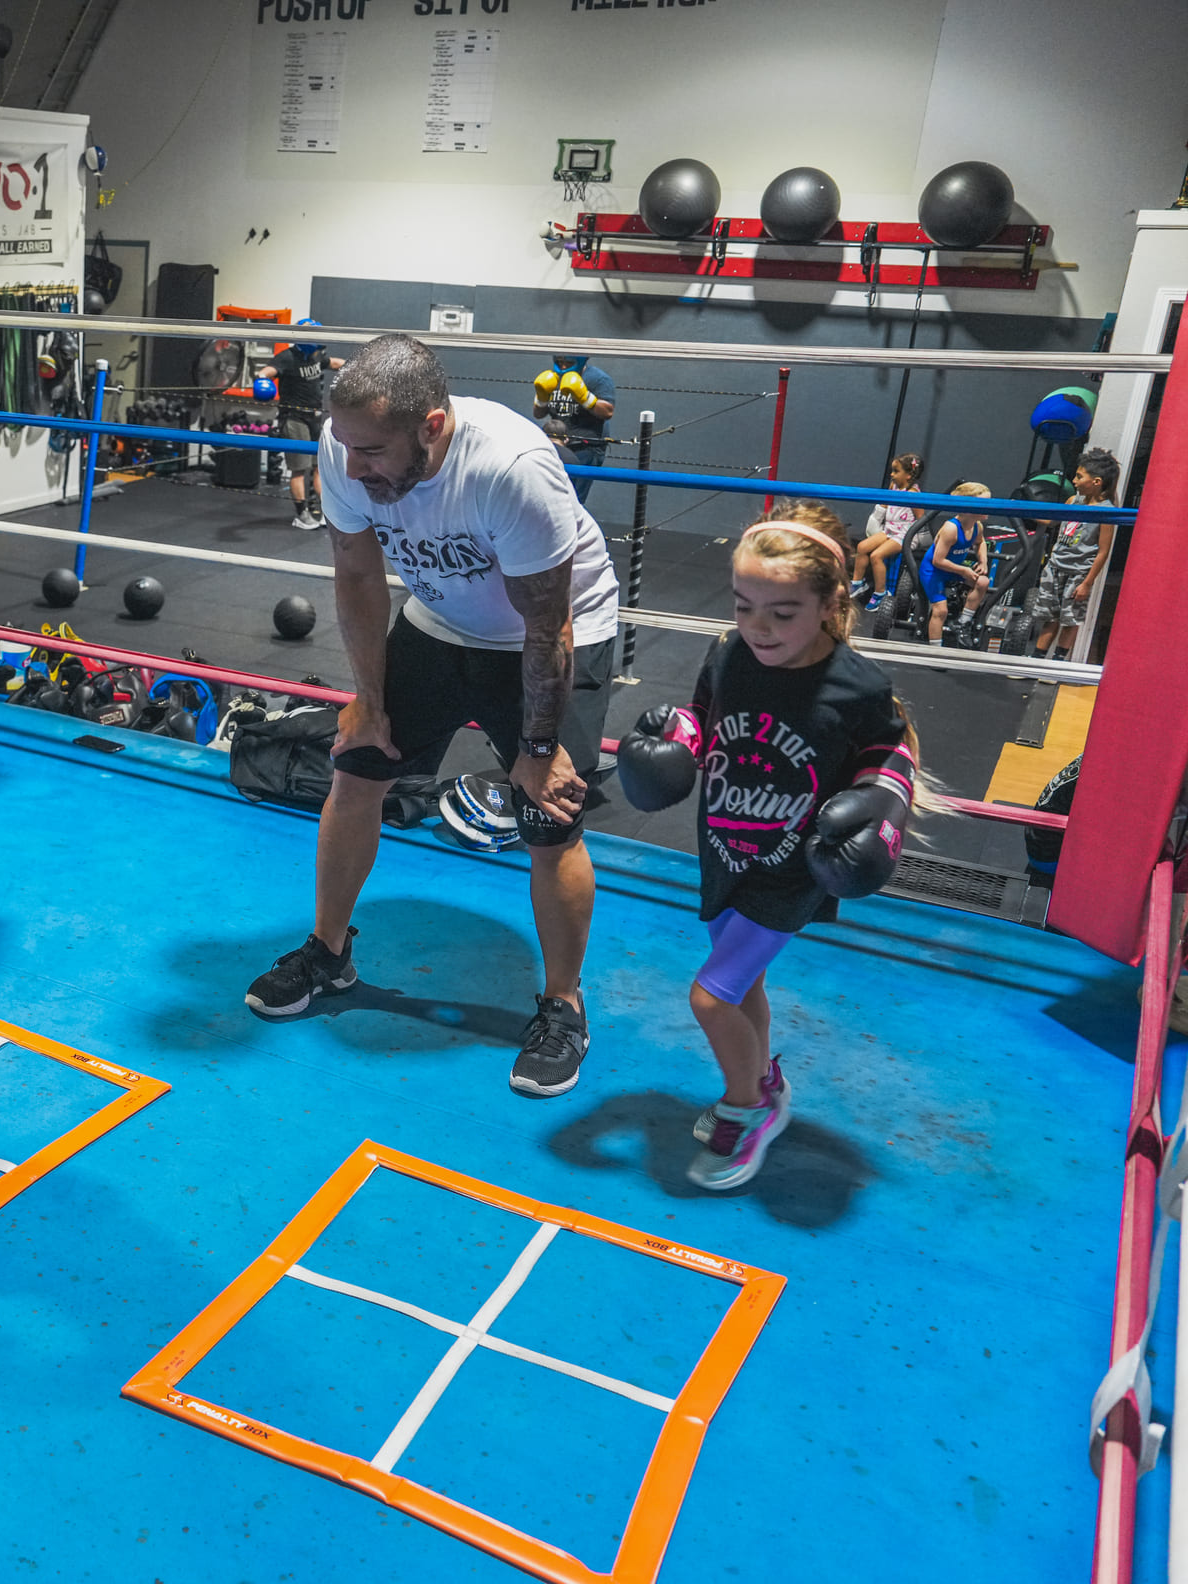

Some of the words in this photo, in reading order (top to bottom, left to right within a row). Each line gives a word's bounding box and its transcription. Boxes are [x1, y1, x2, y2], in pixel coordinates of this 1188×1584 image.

[17, 240, 50, 253] EARNED
[18, 223, 36, 237] JAB
[714, 712, 751, 746] TOE
[754, 712, 773, 743] 2
[771, 721, 817, 768] TOE
[705, 750, 815, 831] Boxing
